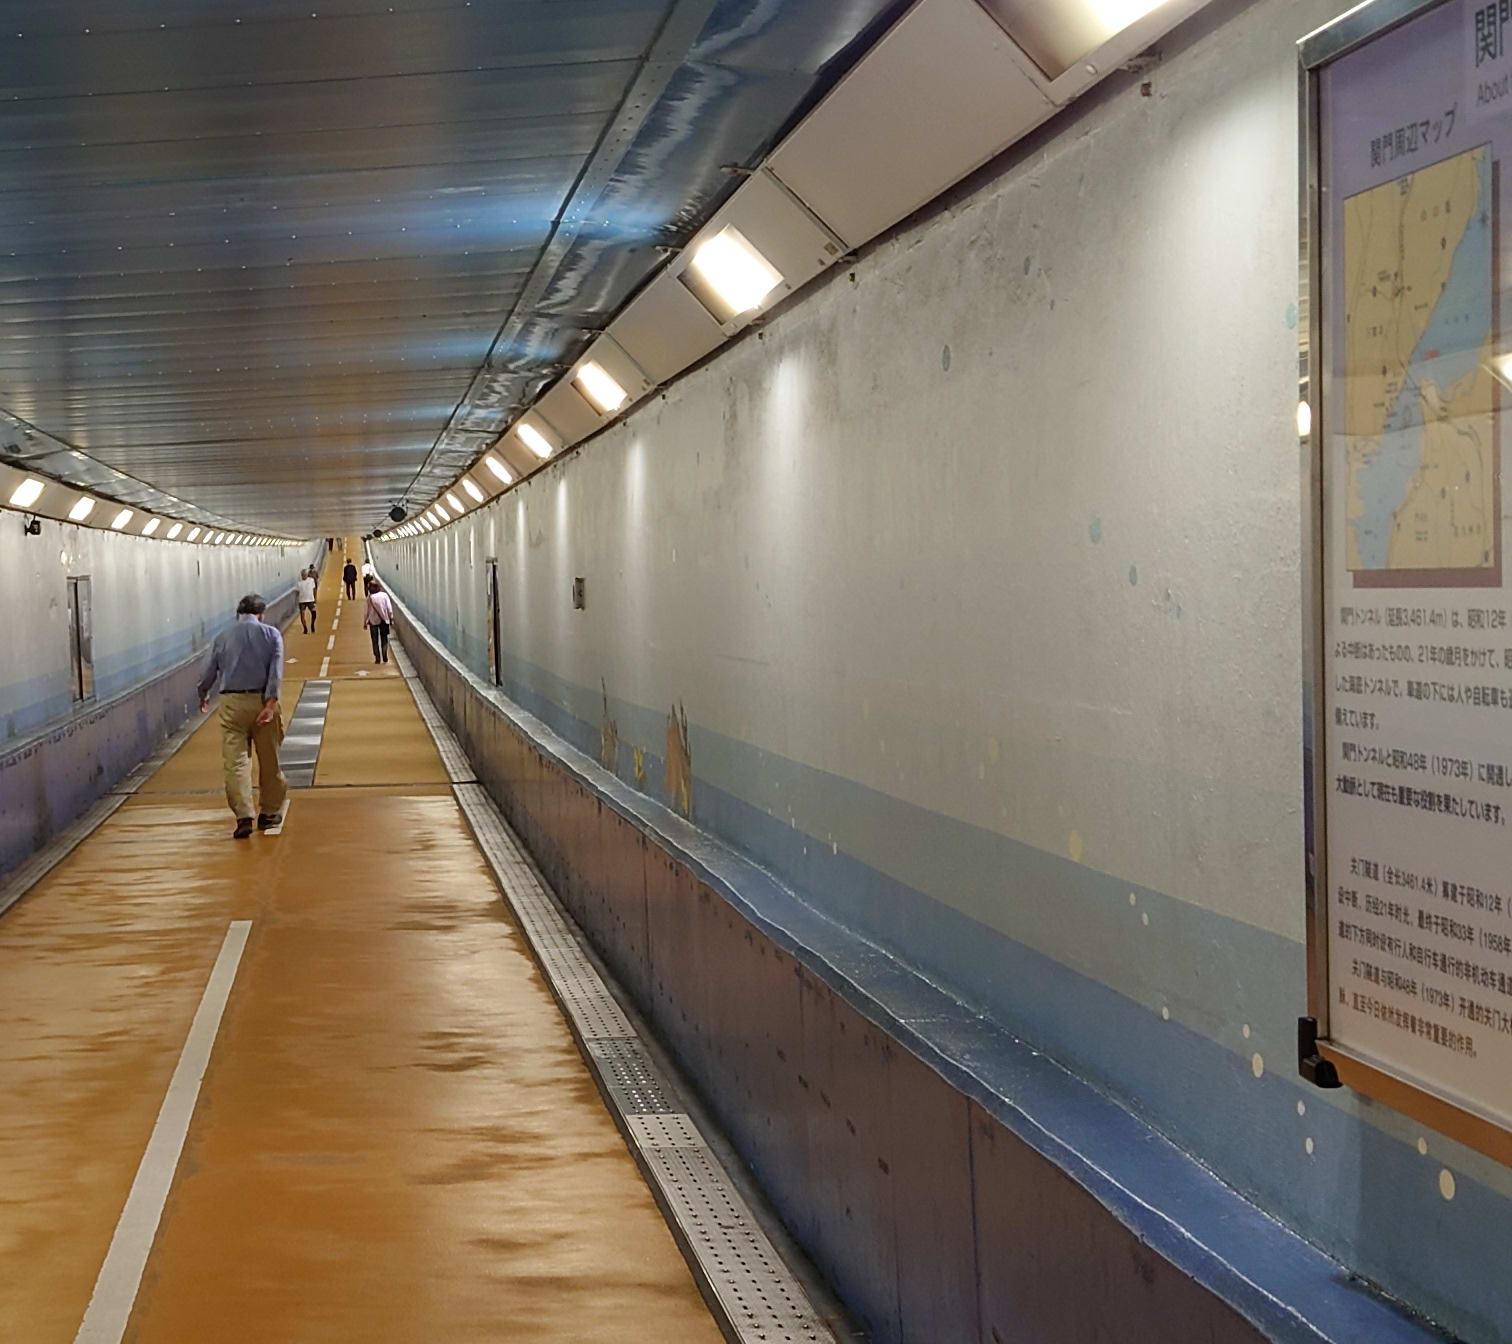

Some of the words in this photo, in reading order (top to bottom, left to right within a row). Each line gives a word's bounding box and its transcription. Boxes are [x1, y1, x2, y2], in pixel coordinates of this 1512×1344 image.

[1370, 101, 1458, 168] 関門周辺マップ
